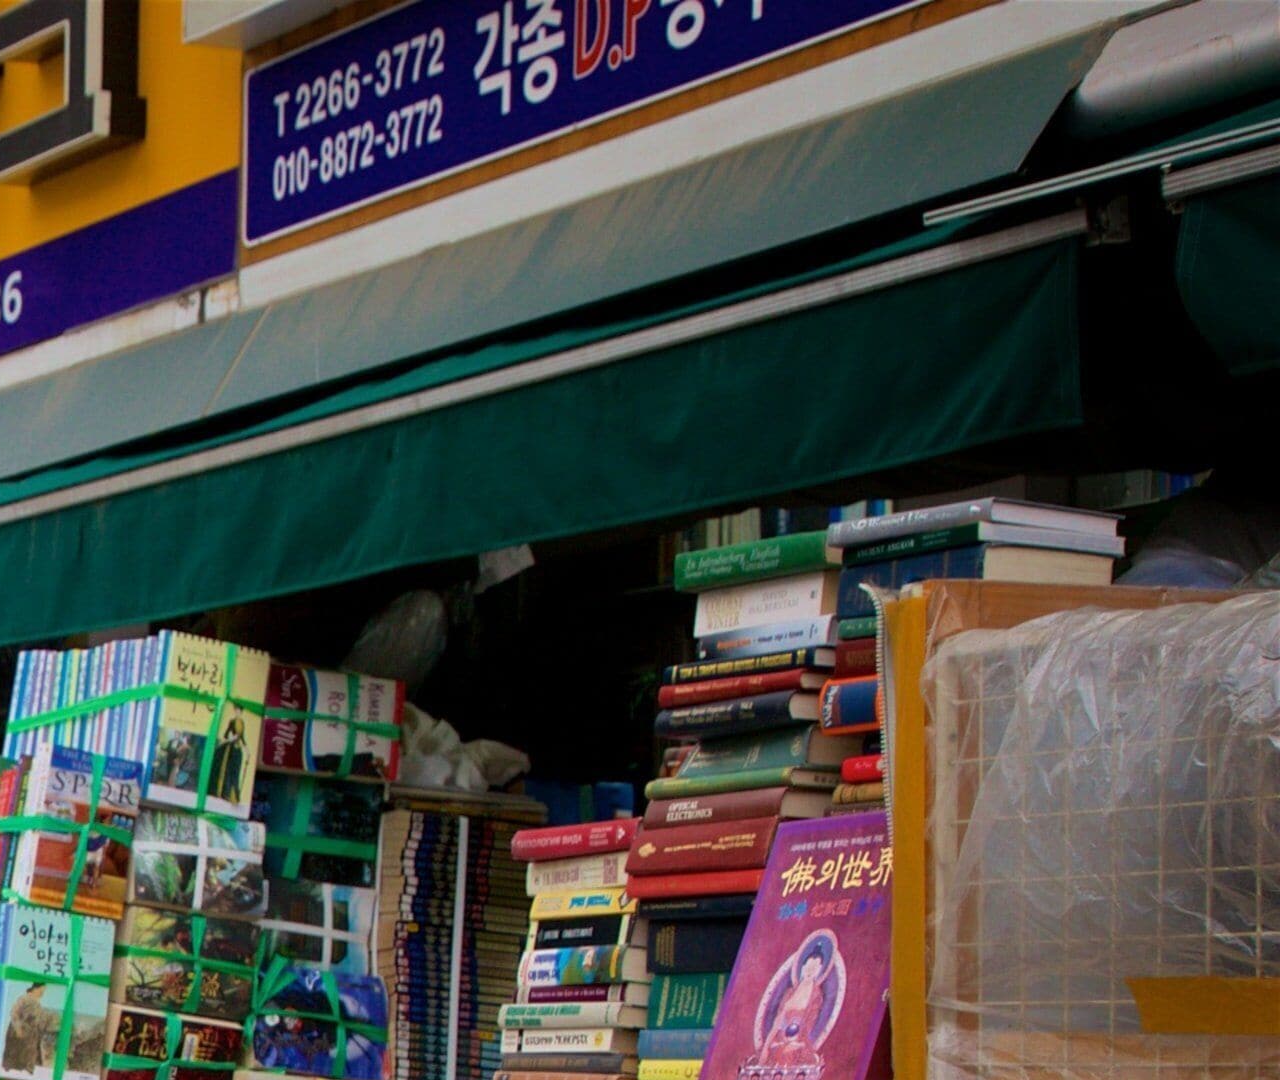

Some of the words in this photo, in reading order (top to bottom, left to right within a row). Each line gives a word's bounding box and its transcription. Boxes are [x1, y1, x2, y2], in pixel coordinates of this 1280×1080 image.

[273, 92, 290, 138] T
[294, 27, 446, 130] 2266-3772
[272, 94, 443, 201] 010-8872-3772
[781, 847, 893, 897] 佛의世界
